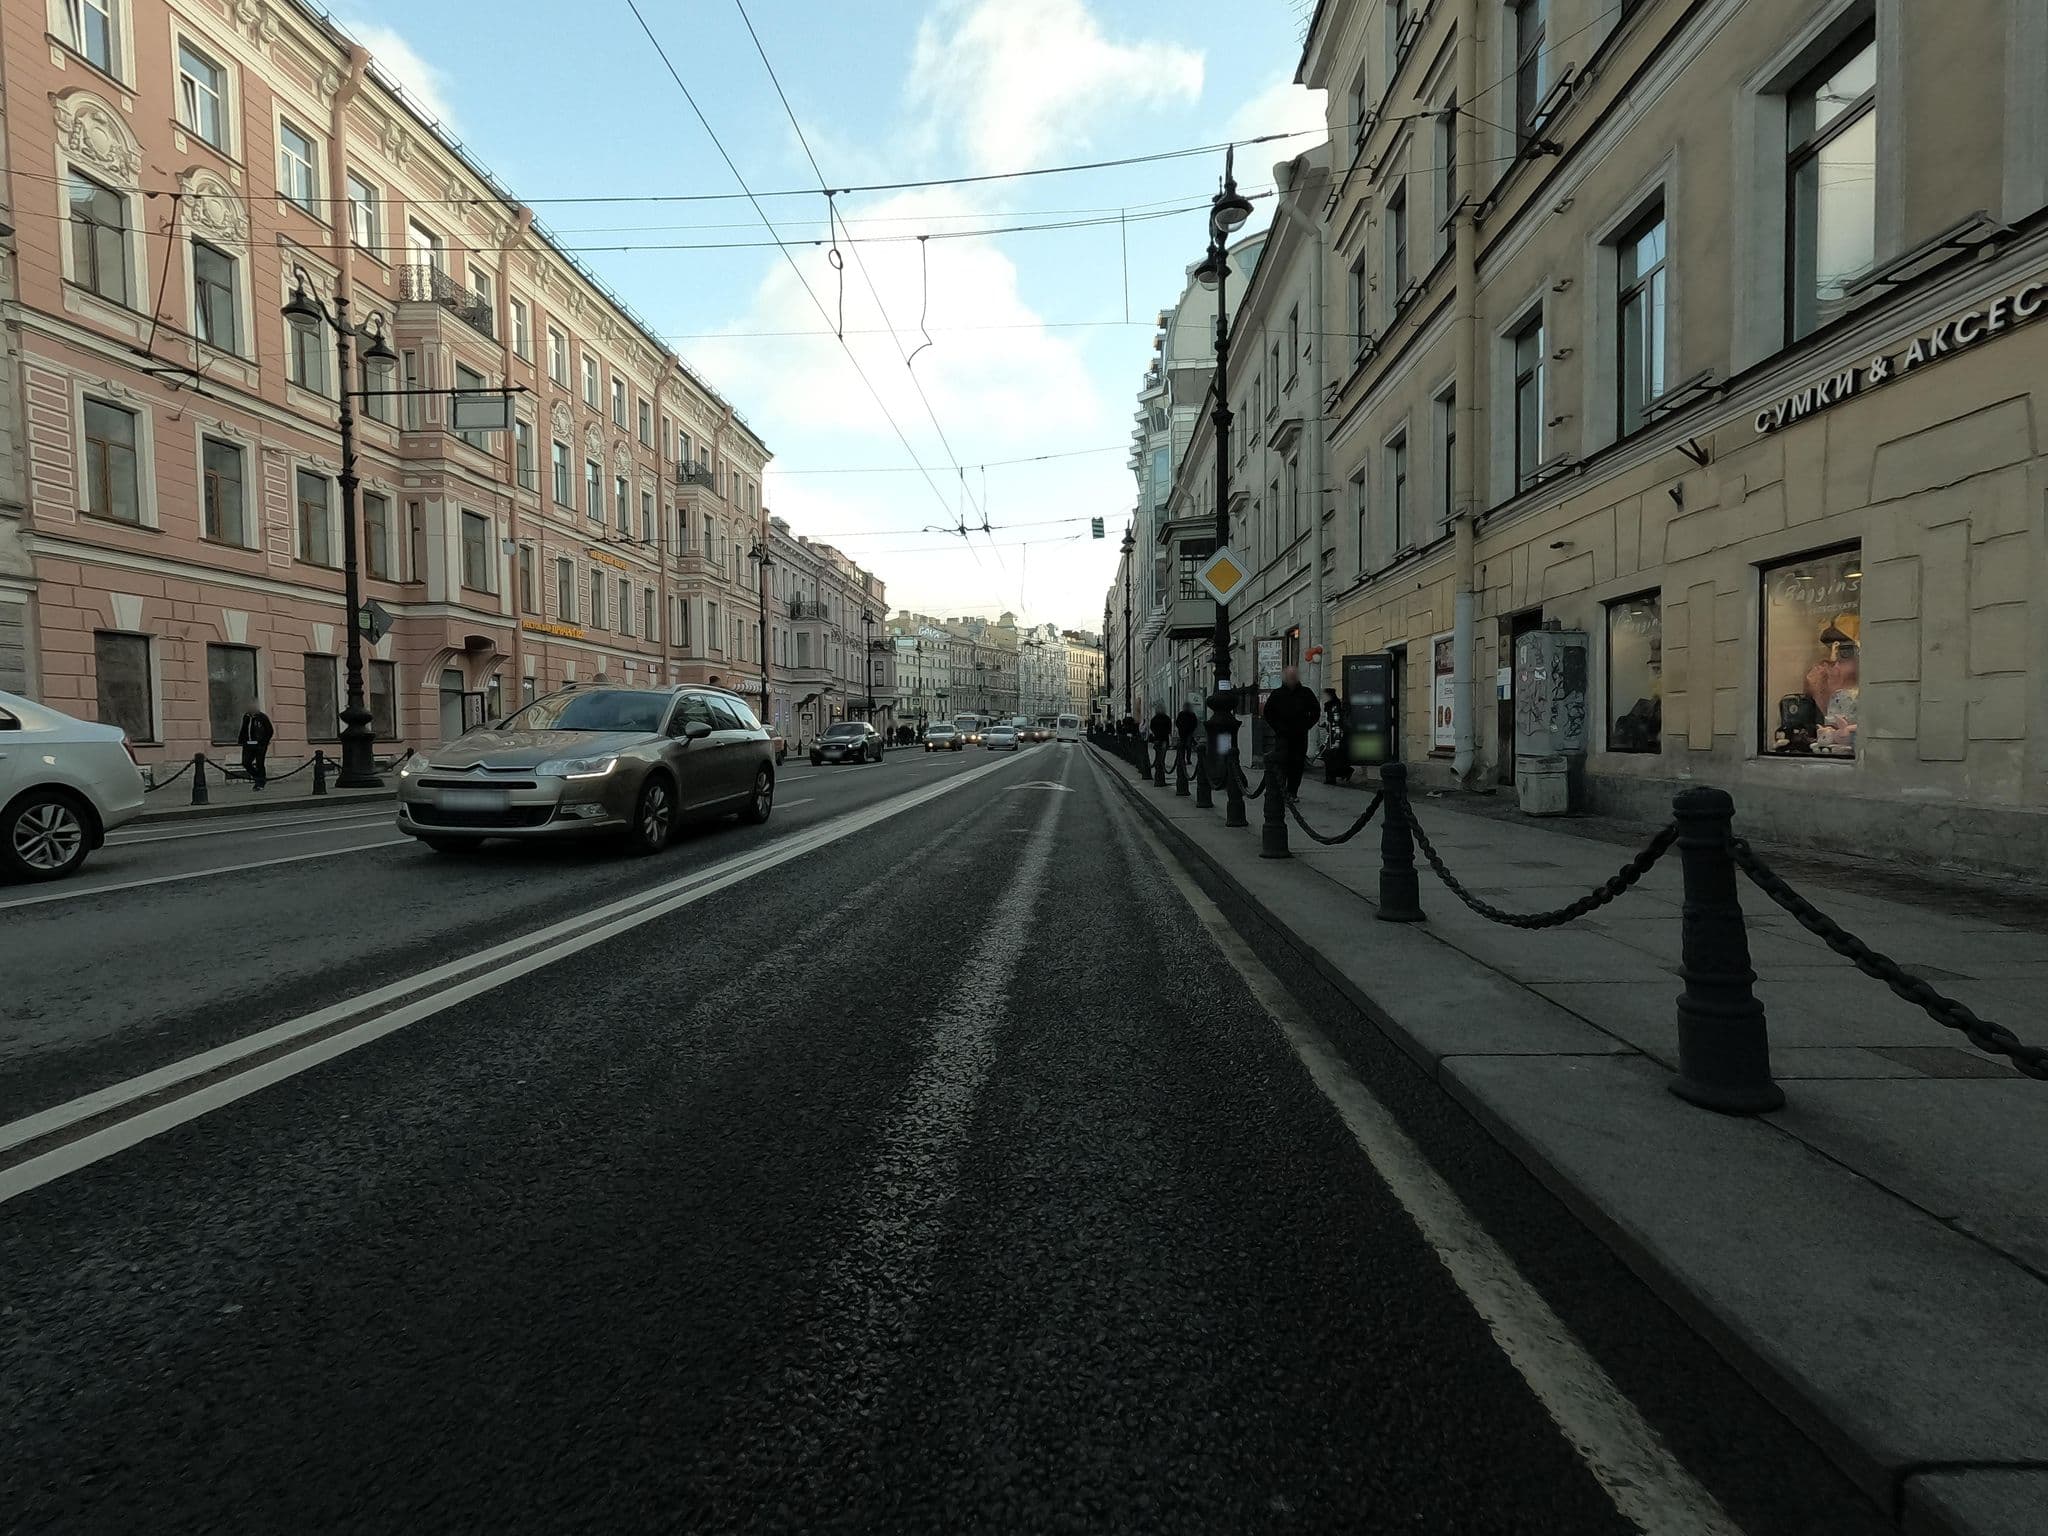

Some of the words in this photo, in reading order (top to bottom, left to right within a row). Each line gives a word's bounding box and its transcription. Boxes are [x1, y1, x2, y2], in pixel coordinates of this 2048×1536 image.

[1755, 368, 1854, 433] СУМКИ
[1868, 355, 1889, 383] &
[1903, 282, 2043, 371] АКСЕС
